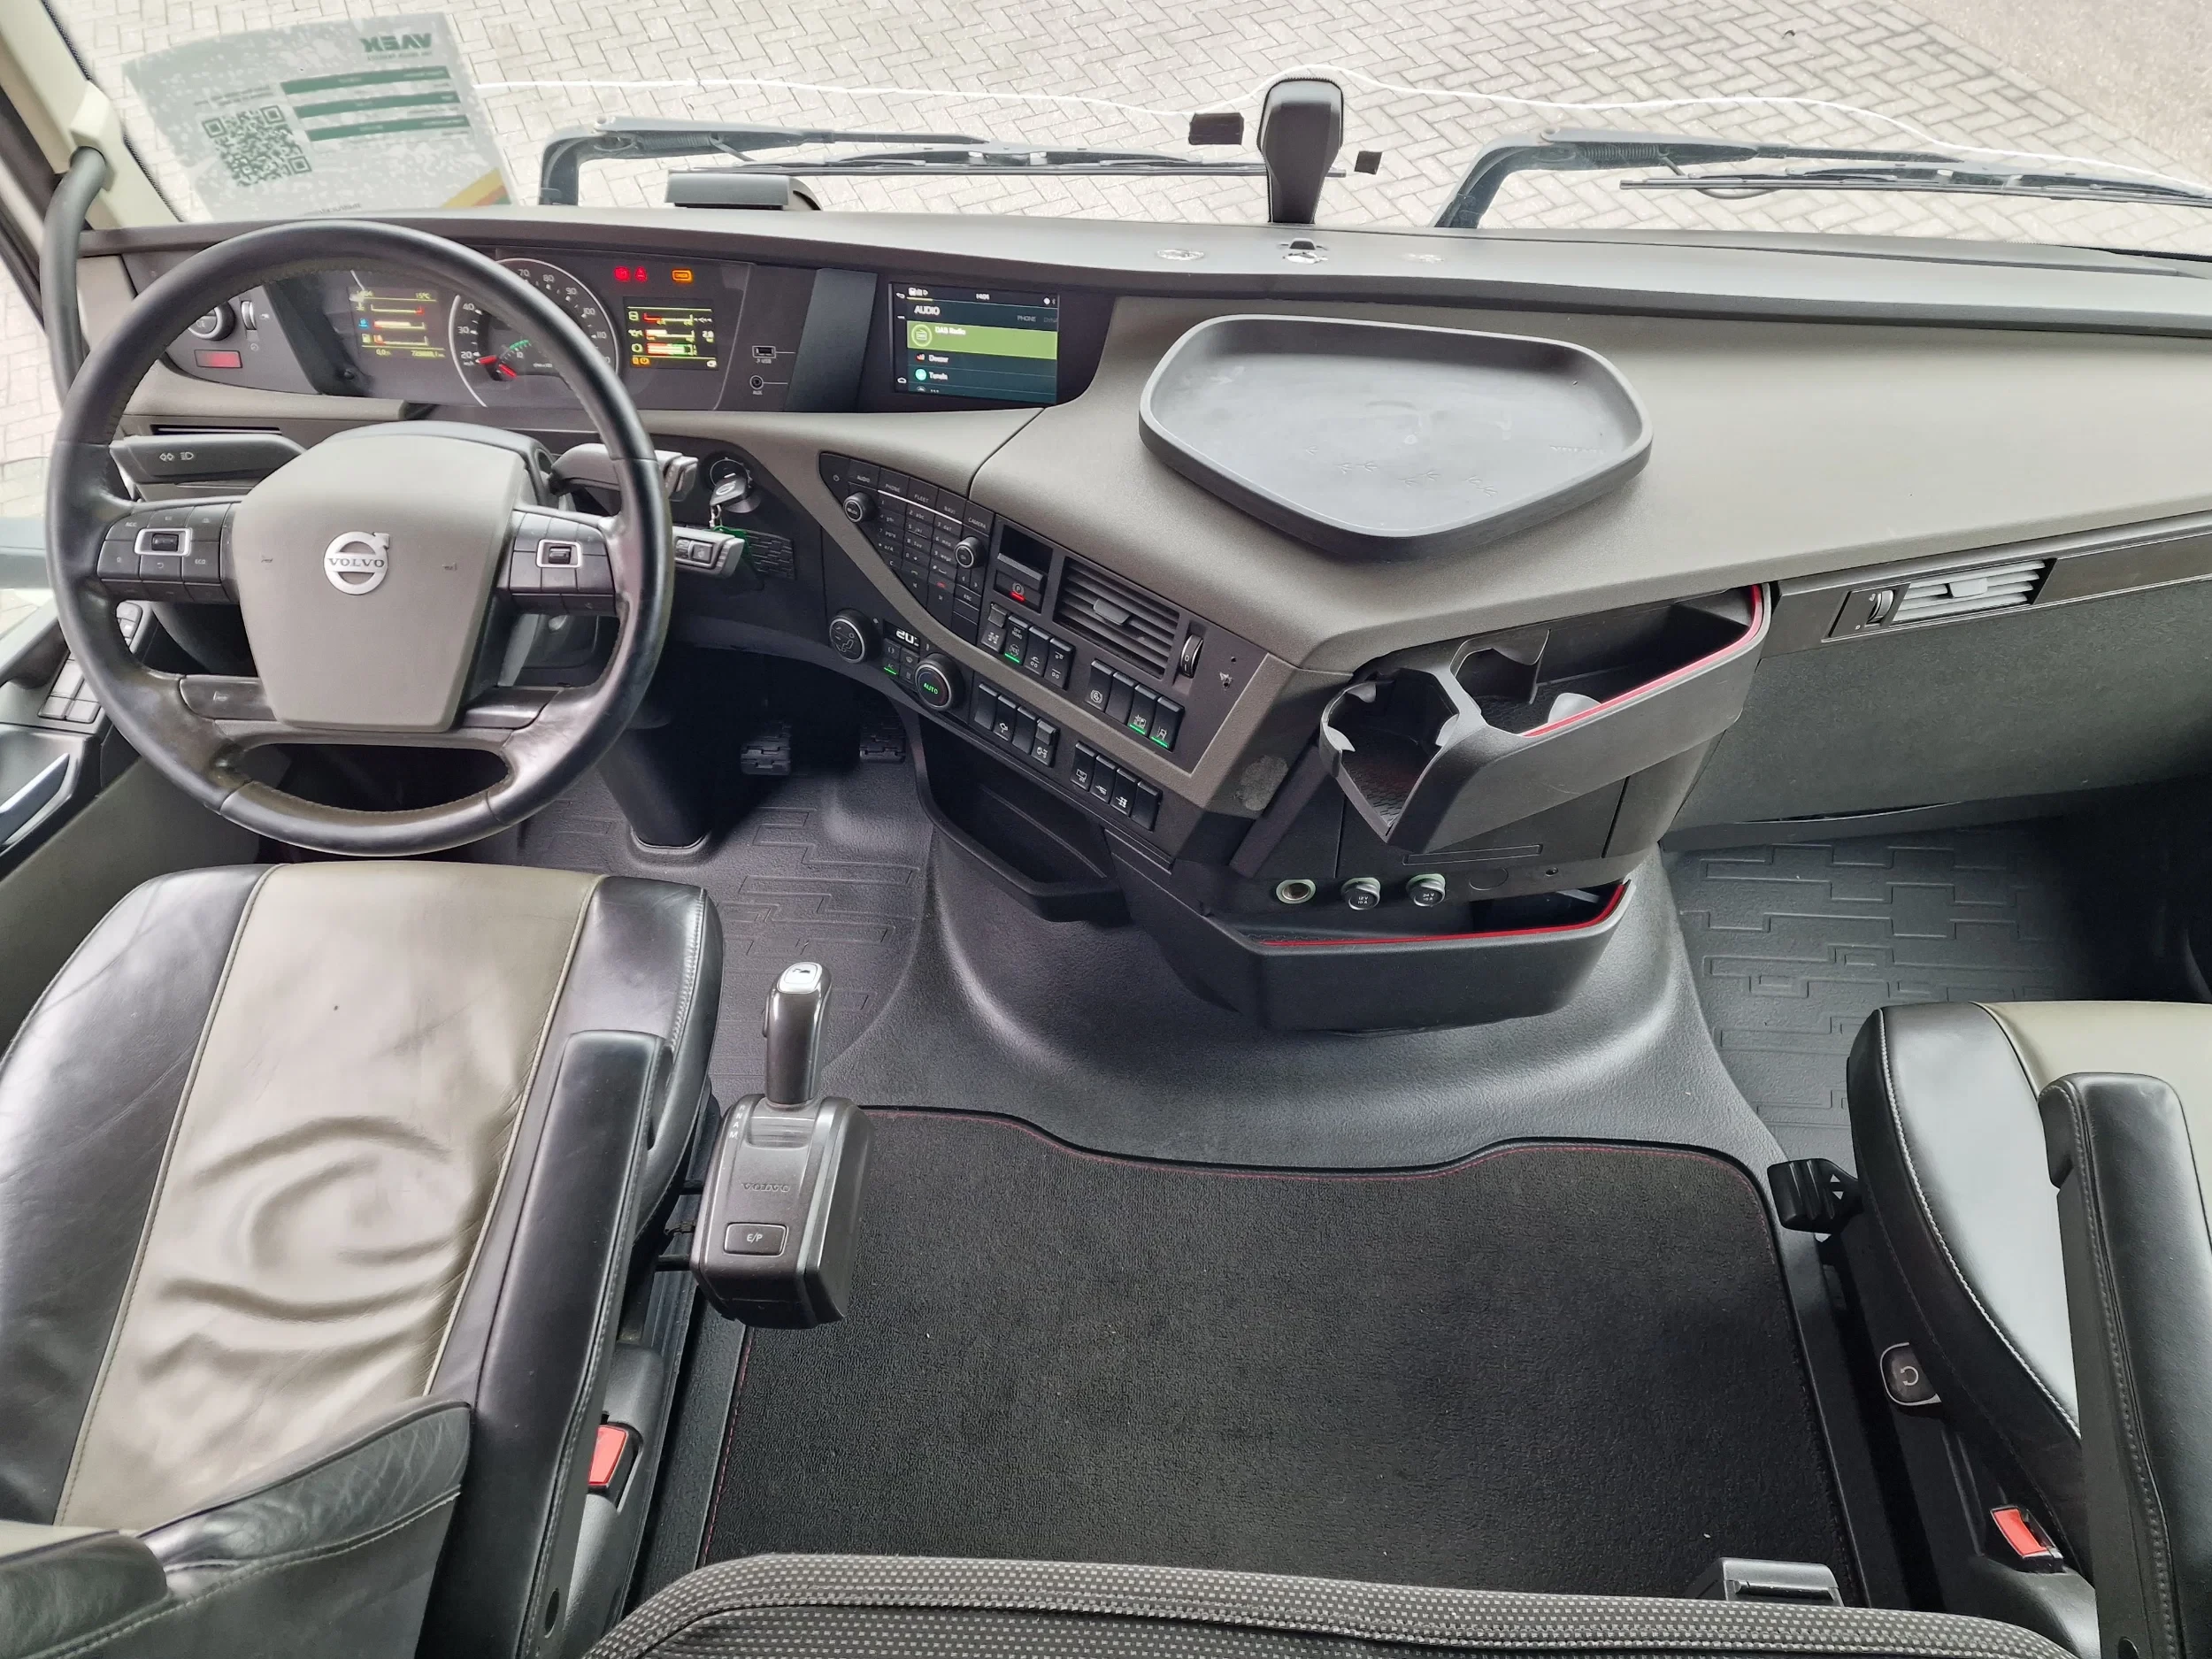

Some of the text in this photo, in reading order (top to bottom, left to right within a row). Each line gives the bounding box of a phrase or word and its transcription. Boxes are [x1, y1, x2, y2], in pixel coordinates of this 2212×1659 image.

[583, 307, 595, 316] 100
[914, 305, 941, 316] AUDIO
[460, 350, 472, 359] 20
[885, 483, 901, 493] PHONE
[914, 494, 929, 503] FLEET
[943, 505, 956, 515] NAVI
[968, 517, 987, 530] CAMERA
[327, 557, 386, 568] VOLVO
[1011, 630, 1023, 640] ROAD
[923, 682, 939, 695] AUTO
[741, 1182, 791, 1193] VOLVO
[746, 1232, 763, 1244] E/P
